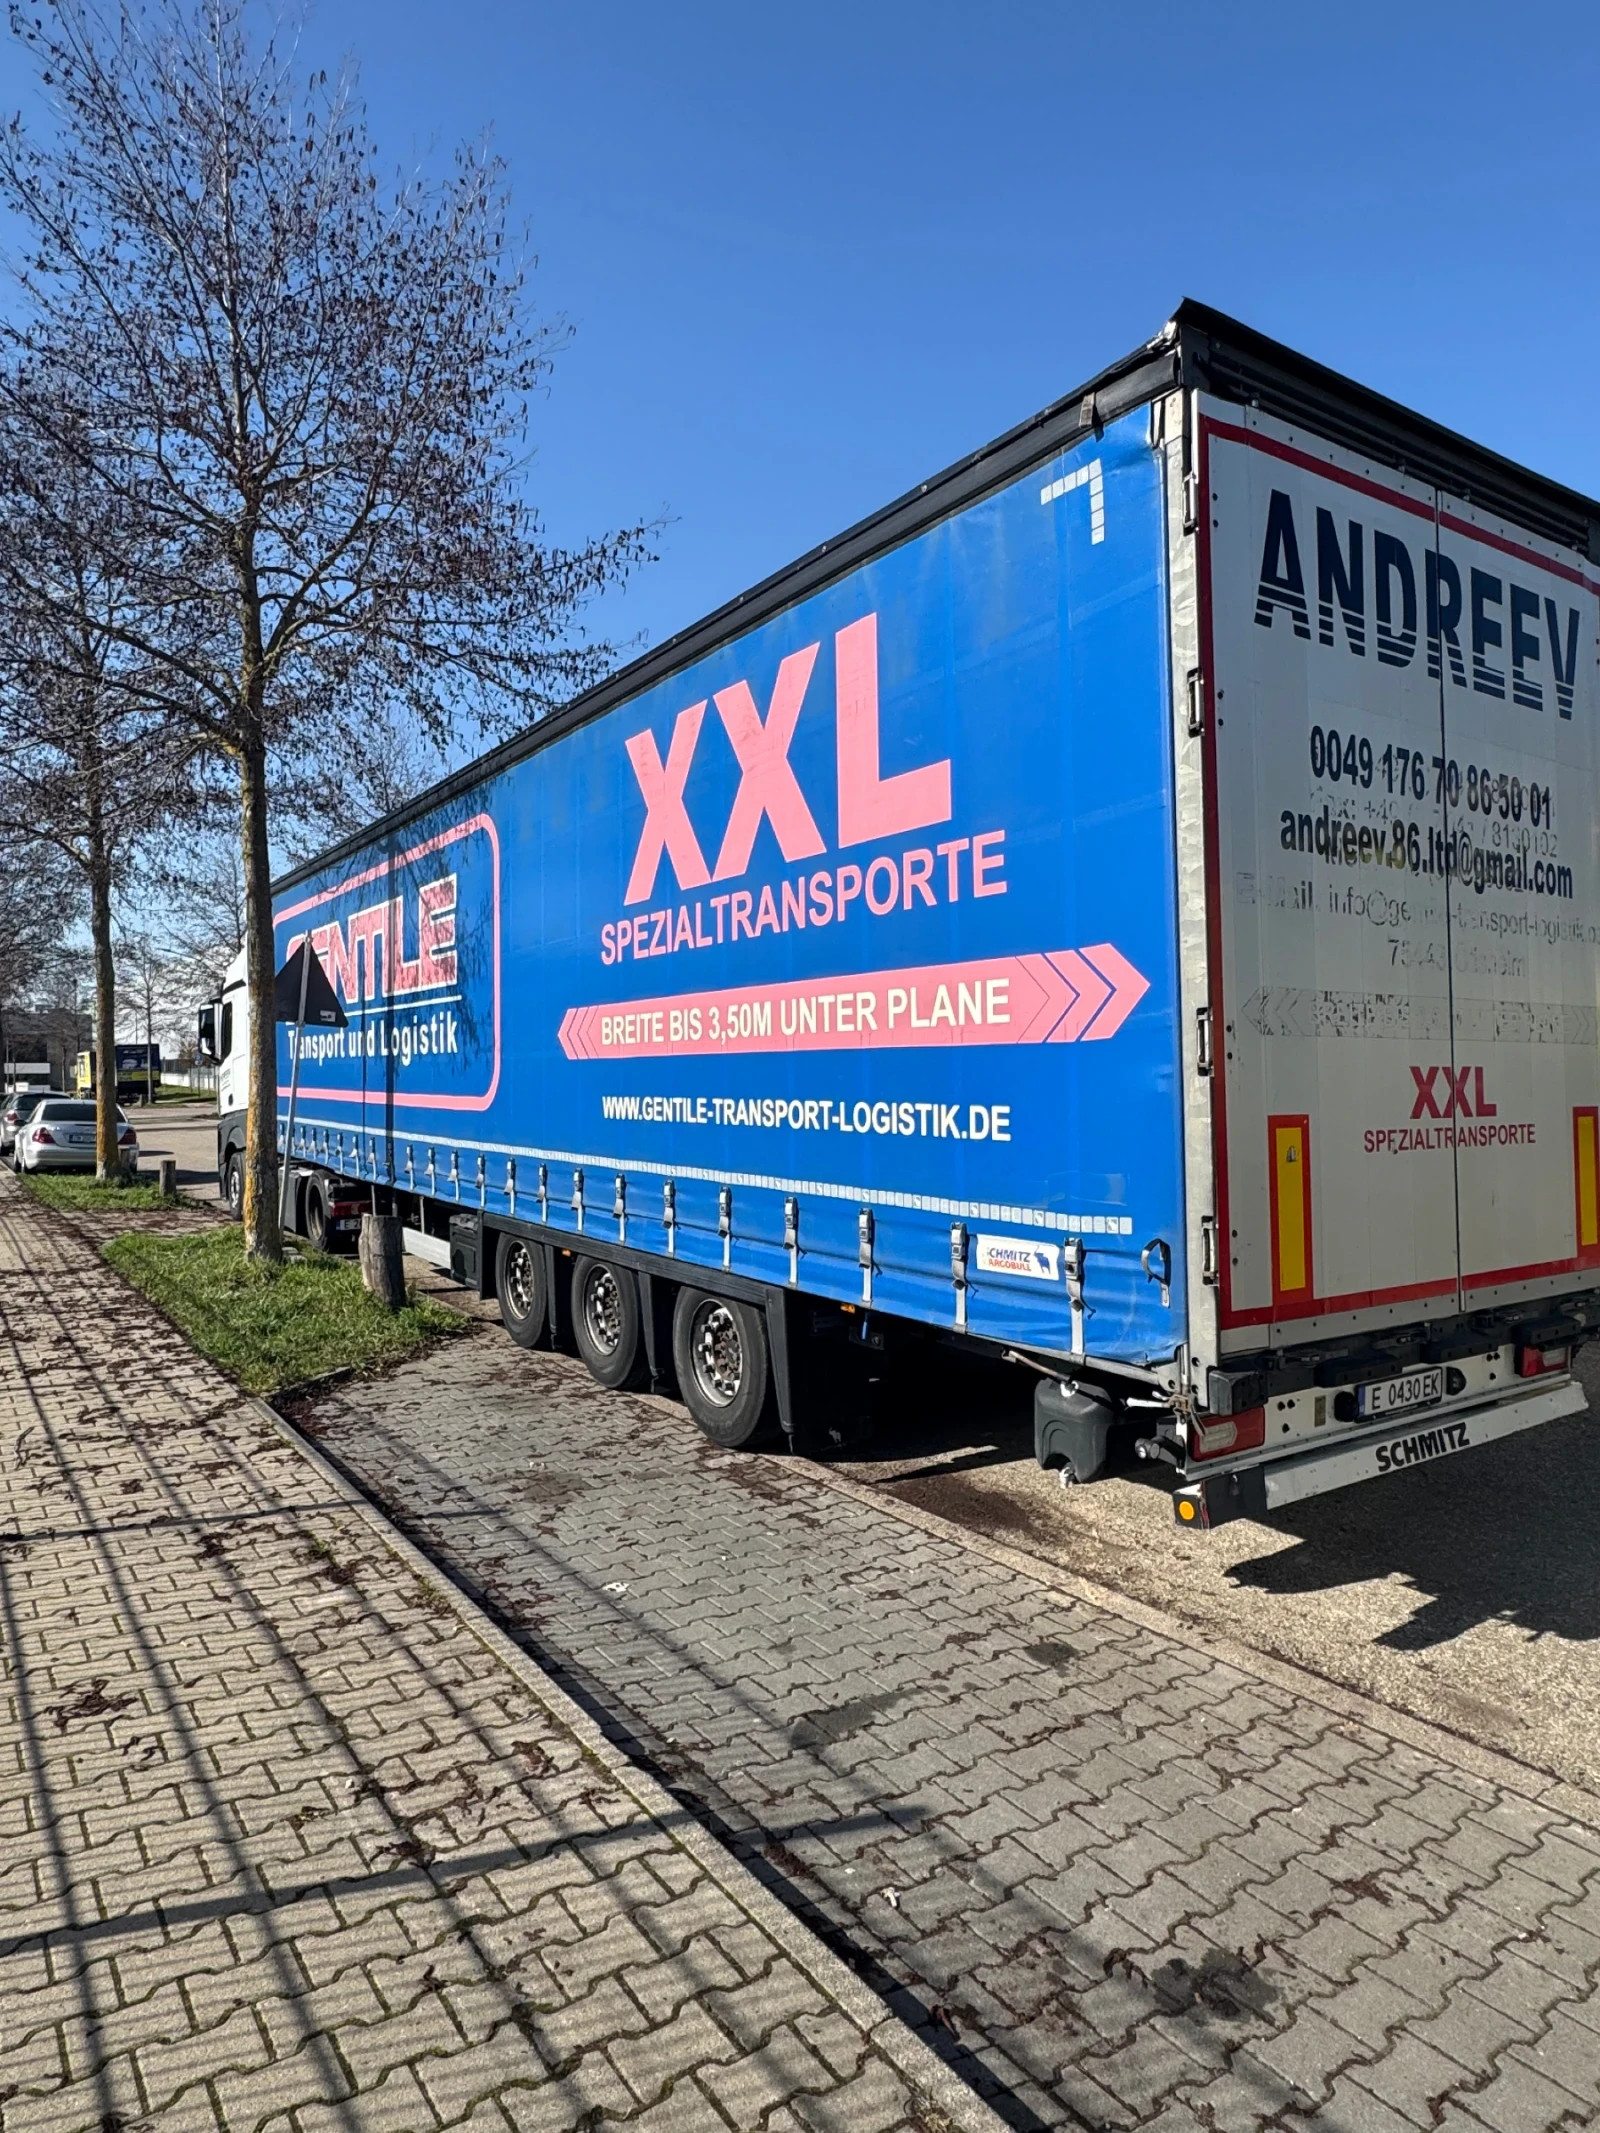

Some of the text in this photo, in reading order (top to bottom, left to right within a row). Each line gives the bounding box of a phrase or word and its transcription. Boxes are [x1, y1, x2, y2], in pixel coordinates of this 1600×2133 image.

[1254, 489, 1580, 721] ANDREEV
[624, 612, 952, 906] XXL
[1310, 725, 1373, 789] 0049
[1383, 743, 1425, 801] 176
[1281, 804, 1573, 899] andreev.86.ltd@gmail.com
[601, 830, 1008, 966] SPEZIALTRANSPORTE
[287, 1011, 458, 1066] Tansport und Logistik
[601, 977, 1011, 1046] BREITE BIS 3,50M UNTER PLANE
[602, 1095, 1012, 1143] WWW.GENTILE-TRANSPORT-LOGISTIK.DE
[1409, 1065, 1498, 1120] XXL
[1372, 1386, 1381, 1410] E
[1389, 1378, 1420, 1406] 0430
[1423, 1372, 1439, 1398] EK
[1375, 1421, 1470, 1473] SCHMITZ
